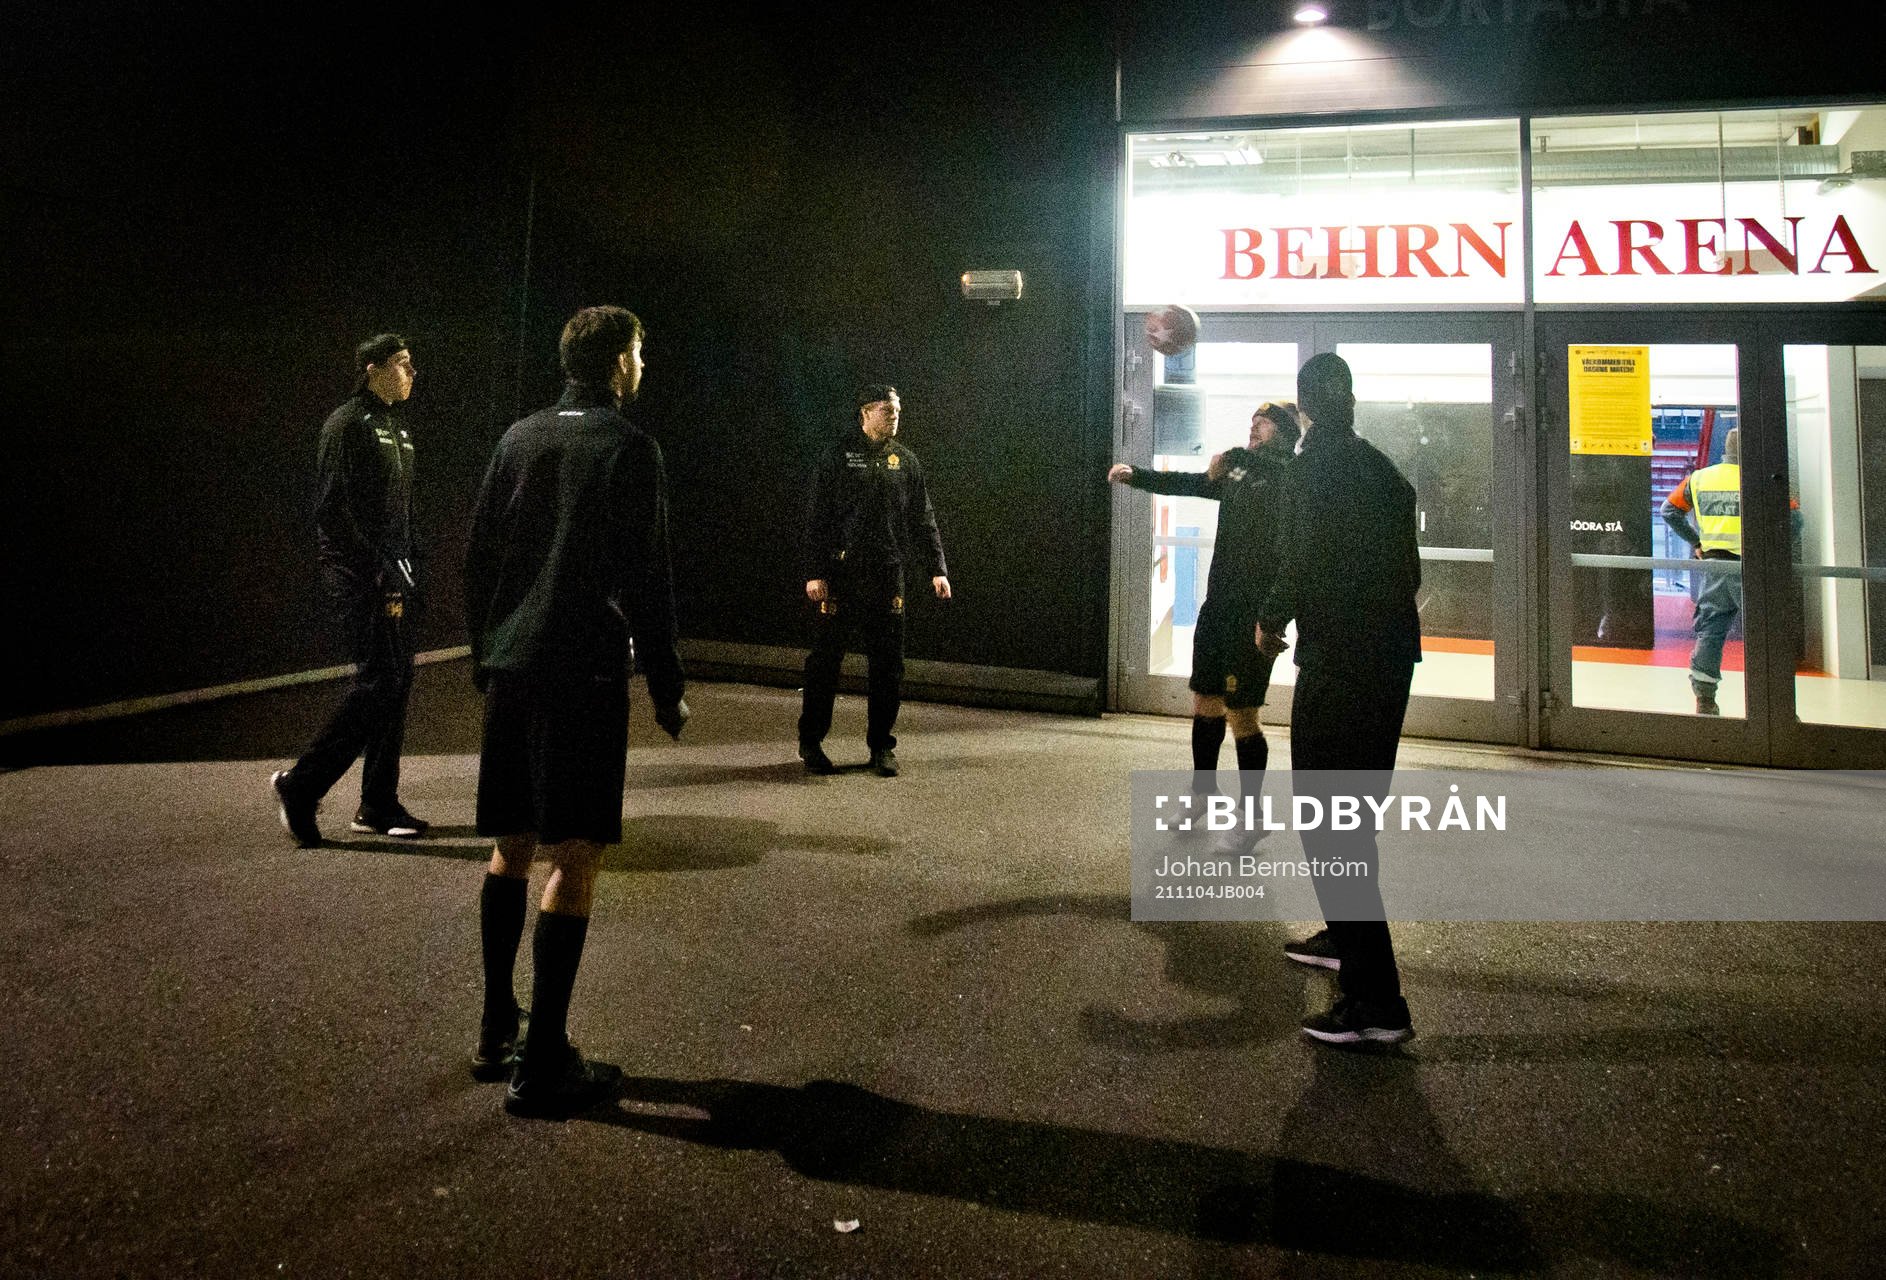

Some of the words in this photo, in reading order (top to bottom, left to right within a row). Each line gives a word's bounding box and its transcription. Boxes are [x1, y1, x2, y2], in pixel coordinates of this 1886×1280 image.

[1219, 221, 1513, 280] BEHRN
[1544, 214, 1879, 276] ARENA
[1605, 520, 1624, 532] STÅ
